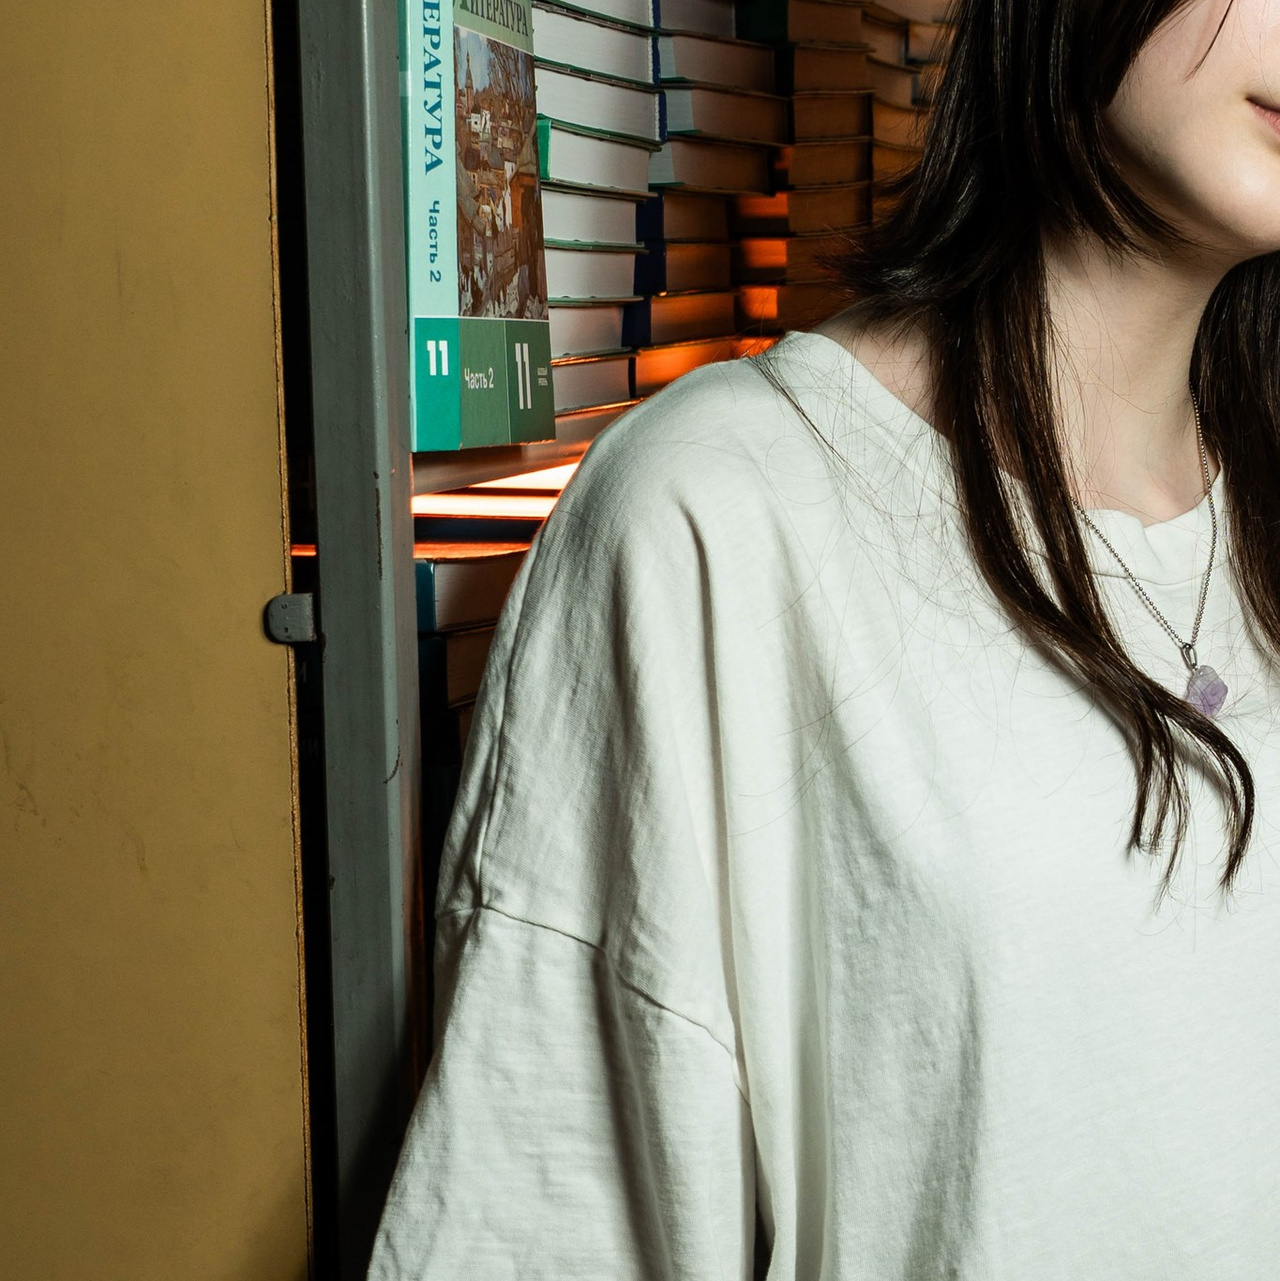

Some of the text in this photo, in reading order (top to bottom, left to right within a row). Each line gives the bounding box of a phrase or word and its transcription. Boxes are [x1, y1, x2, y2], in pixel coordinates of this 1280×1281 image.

[428, 200, 440, 264] Часть
[429, 270, 442, 283] 2
[426, 340, 449, 376] 11
[515, 342, 532, 410] 11
[464, 367, 494, 389] Часть 2
